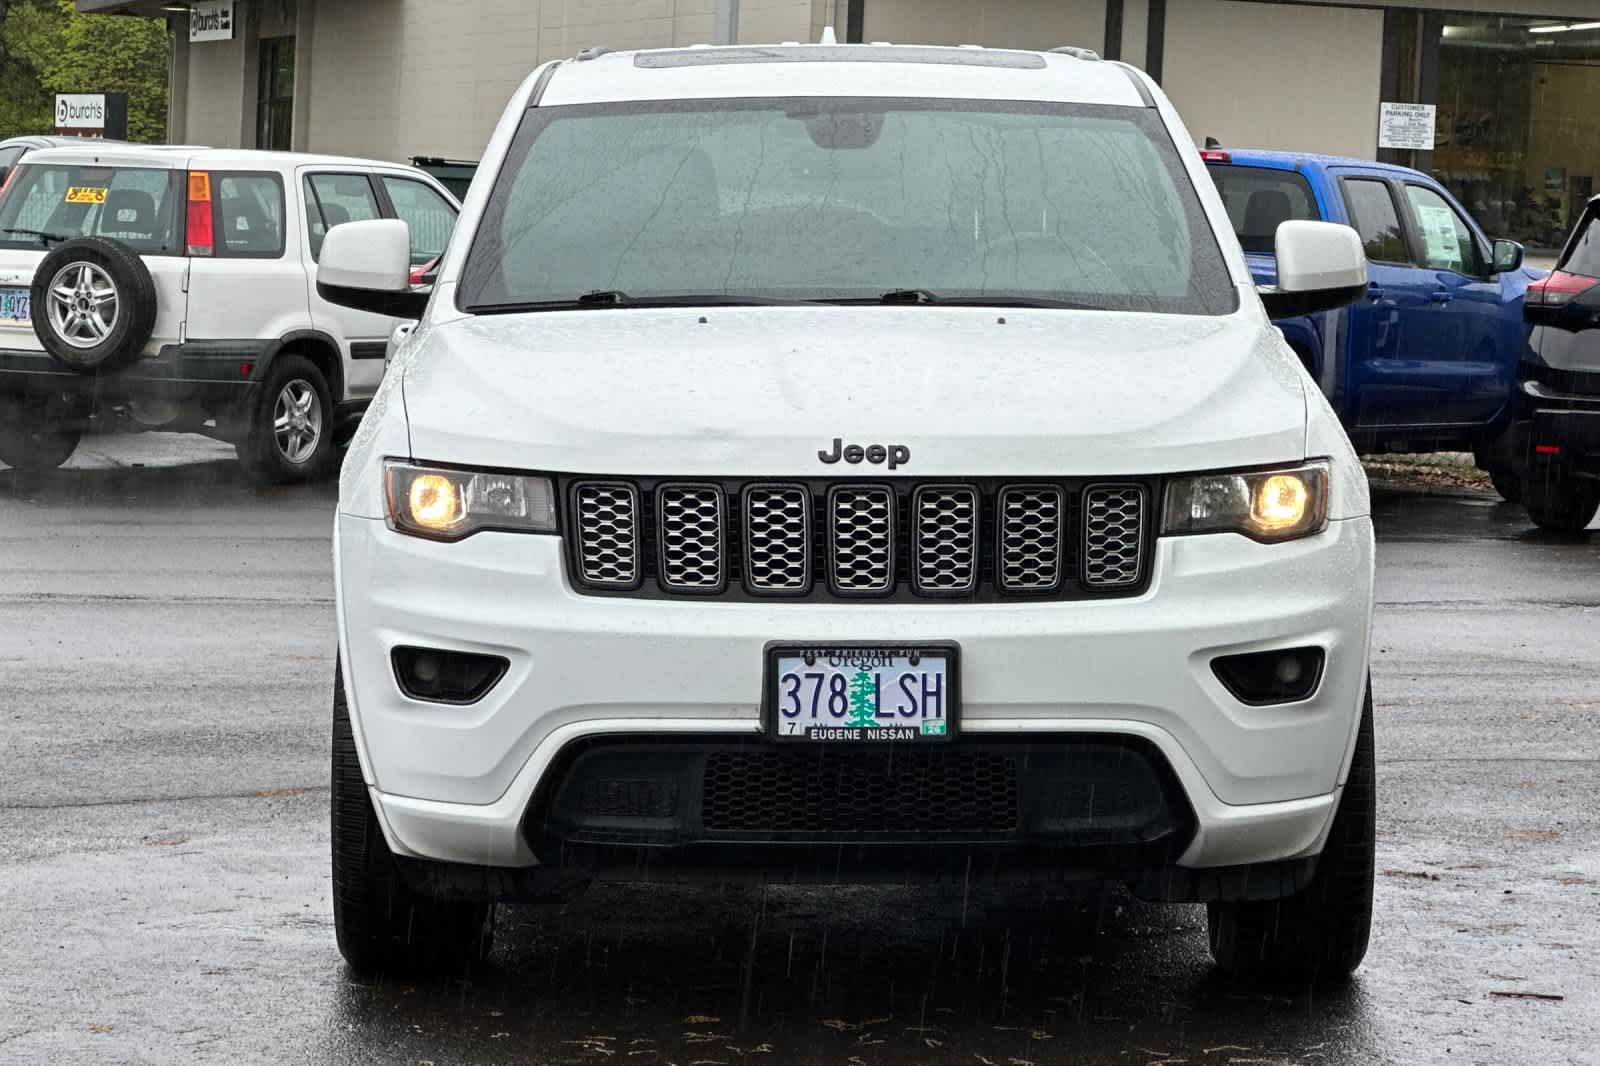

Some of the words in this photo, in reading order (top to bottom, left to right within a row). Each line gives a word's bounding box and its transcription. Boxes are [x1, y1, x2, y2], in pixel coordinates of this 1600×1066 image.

[69, 102, 103, 119] burch's
[818, 438, 910, 470] Jeep
[781, 673, 849, 718] 378
[874, 673, 942, 718] LSH
[787, 722, 796, 735] 7
[810, 729, 861, 740] EUGENE
[867, 729, 914, 740] NISSAN
